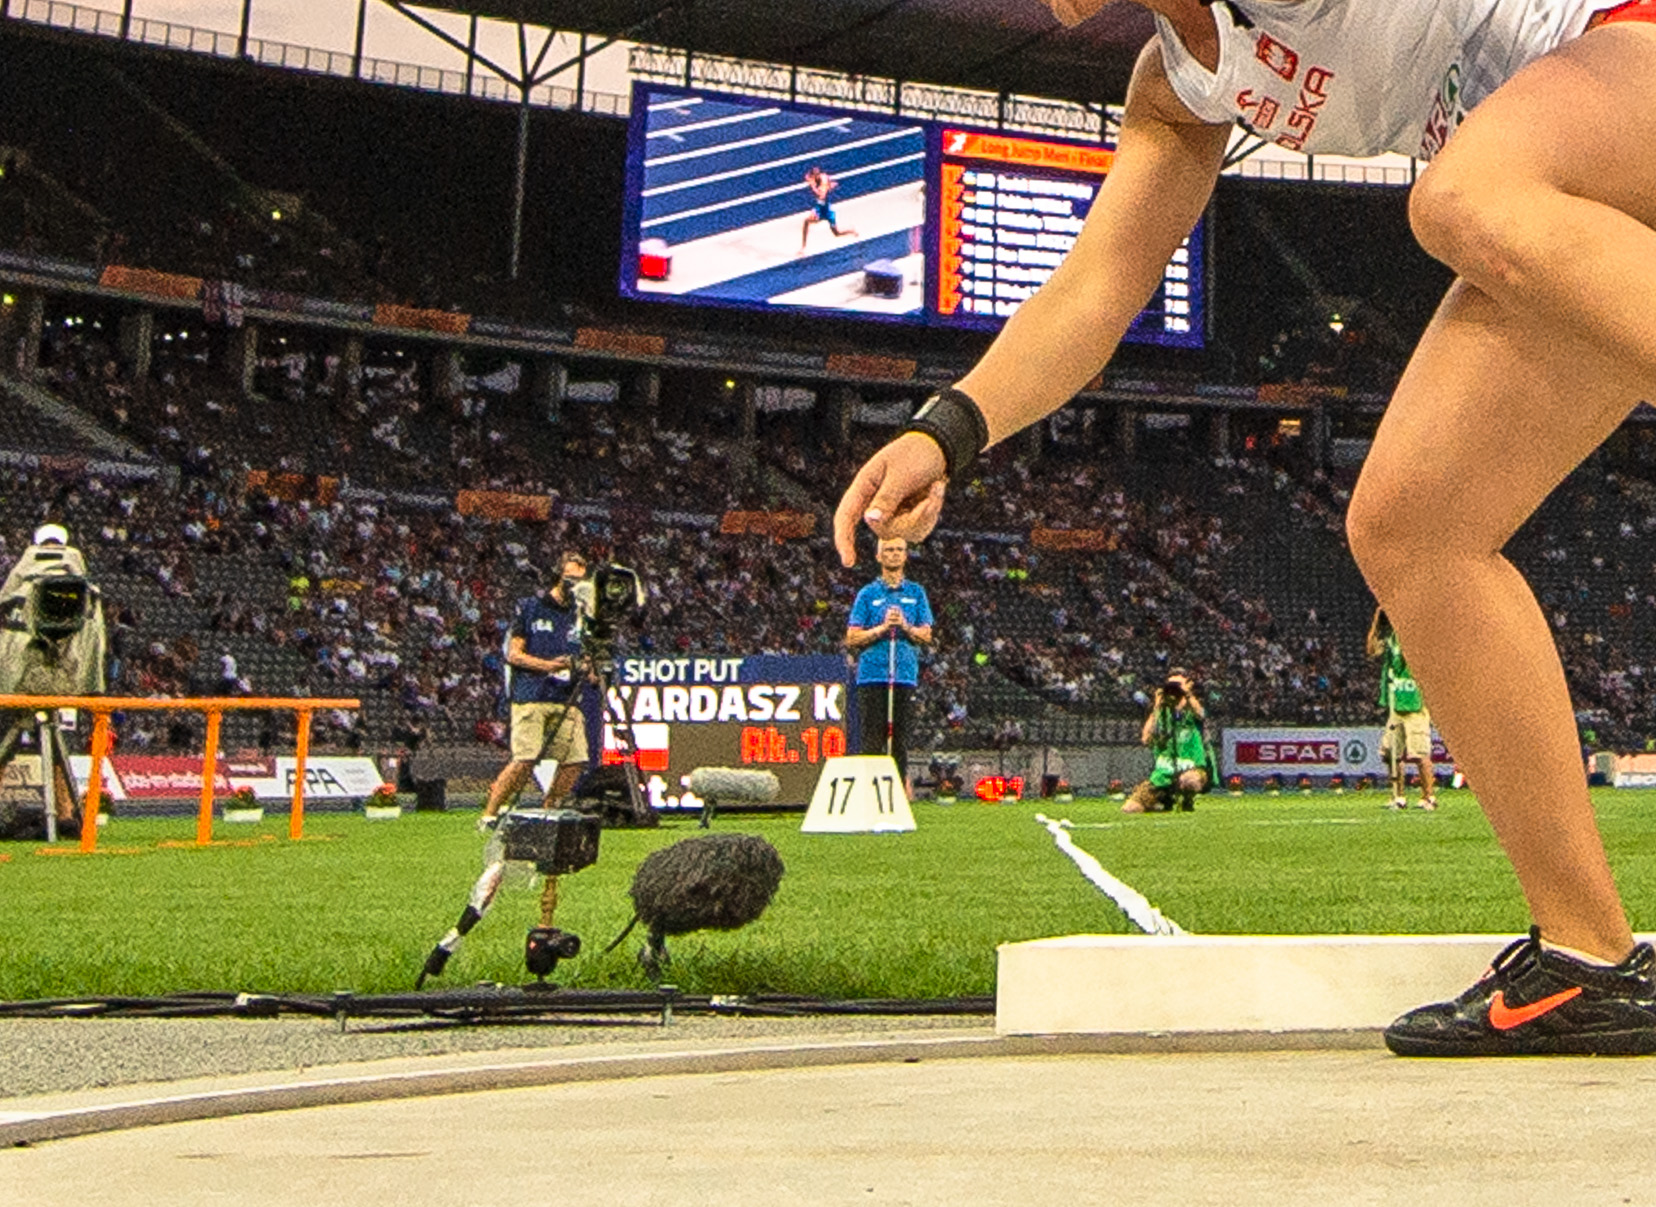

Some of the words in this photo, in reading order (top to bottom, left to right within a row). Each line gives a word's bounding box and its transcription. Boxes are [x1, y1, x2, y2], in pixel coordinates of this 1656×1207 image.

[1275, 65, 1334, 151] OLSKA
[624, 659, 689, 682] SHOT
[694, 659, 743, 682] PUT
[814, 684, 842, 721] K
[1258, 744, 1339, 761] SPAR
[828, 777, 855, 814] 17
[873, 776, 894, 813] 17
